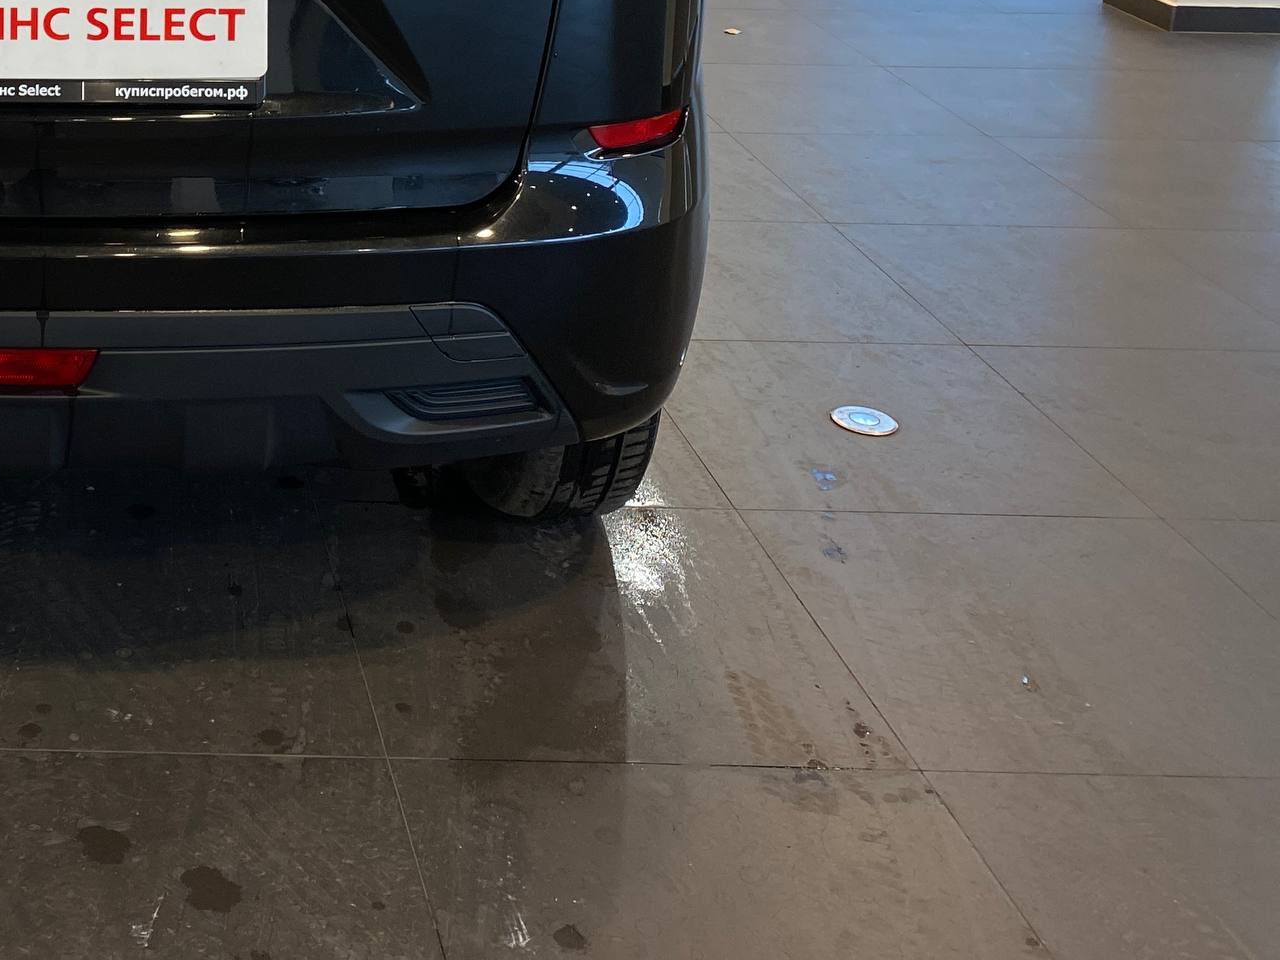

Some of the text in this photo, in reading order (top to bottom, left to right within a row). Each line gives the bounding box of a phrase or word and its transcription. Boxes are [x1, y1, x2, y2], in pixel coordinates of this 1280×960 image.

[86, 7, 246, 42] SELECT
[18, 84, 62, 97] Select
[115, 84, 249, 101] куписпробегом.рф
